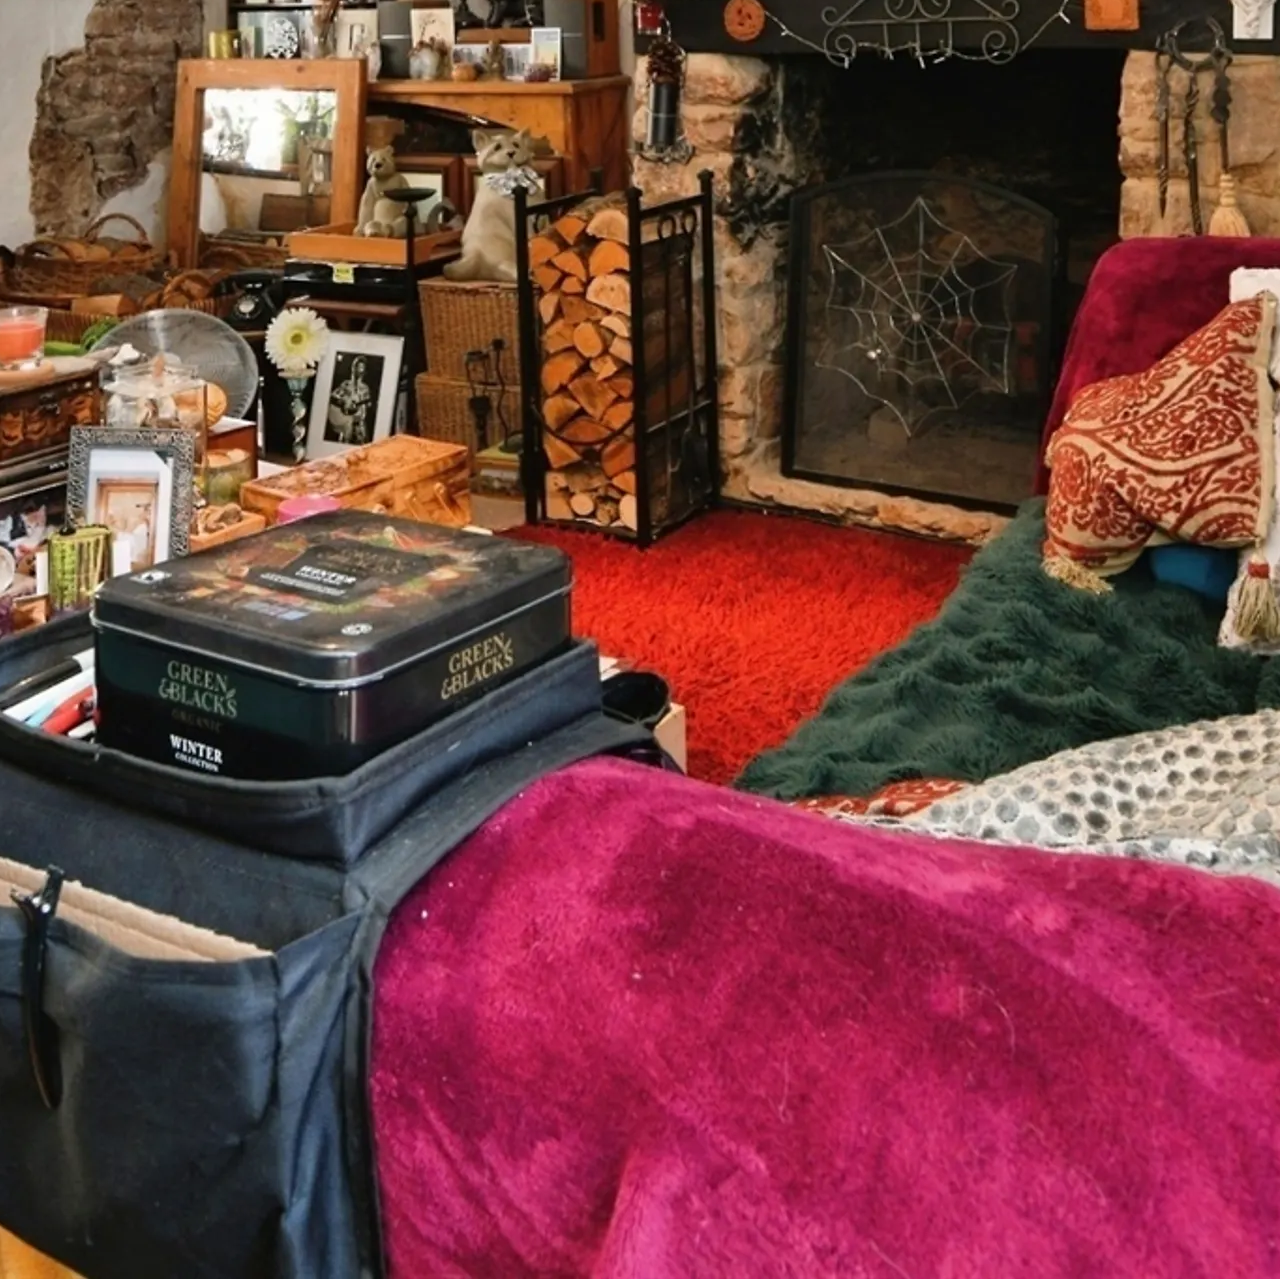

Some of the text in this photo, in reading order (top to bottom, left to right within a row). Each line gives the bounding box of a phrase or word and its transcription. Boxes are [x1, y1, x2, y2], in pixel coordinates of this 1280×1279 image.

[448, 631, 505, 674] GREEN
[167, 659, 228, 693] GREEN
[169, 733, 223, 765] WINTER
